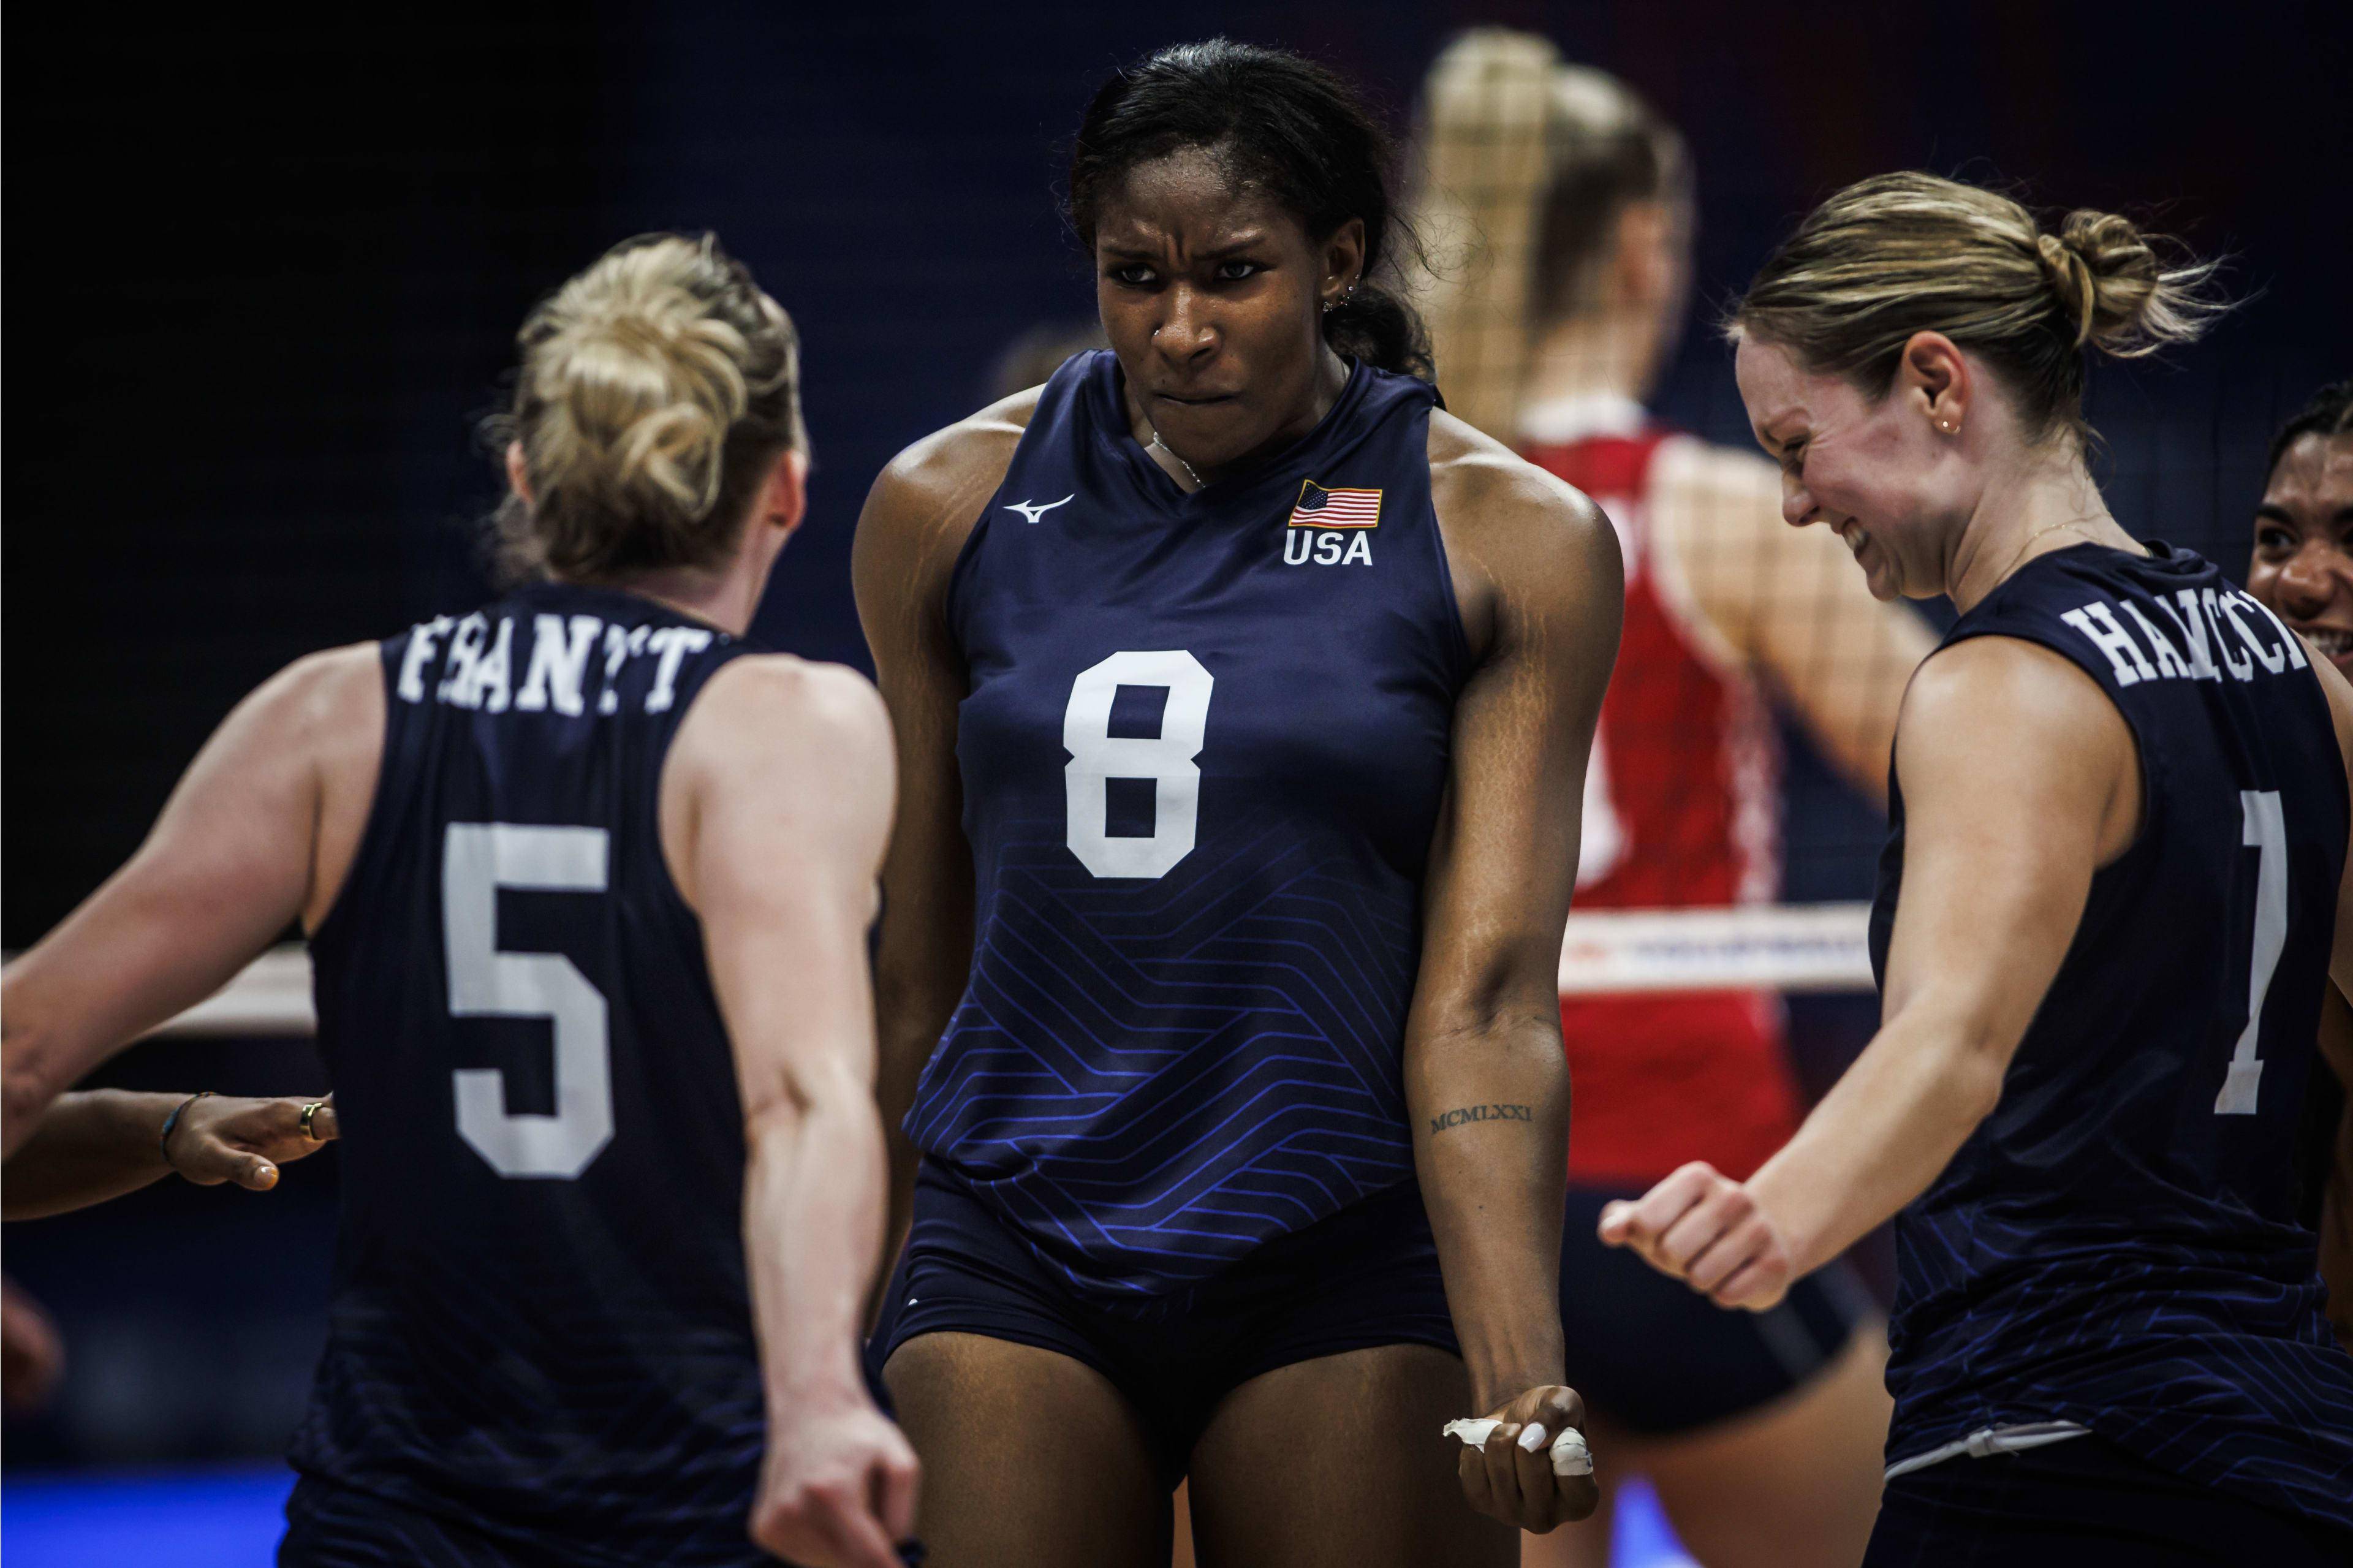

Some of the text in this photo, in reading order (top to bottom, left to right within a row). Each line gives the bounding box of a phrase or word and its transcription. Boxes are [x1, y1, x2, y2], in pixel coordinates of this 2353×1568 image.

[1284, 529, 1373, 566] USA
[1063, 650, 1214, 879] 8
[441, 822, 615, 1180] 5
[1430, 1104, 1532, 1134] MCMLXXI
